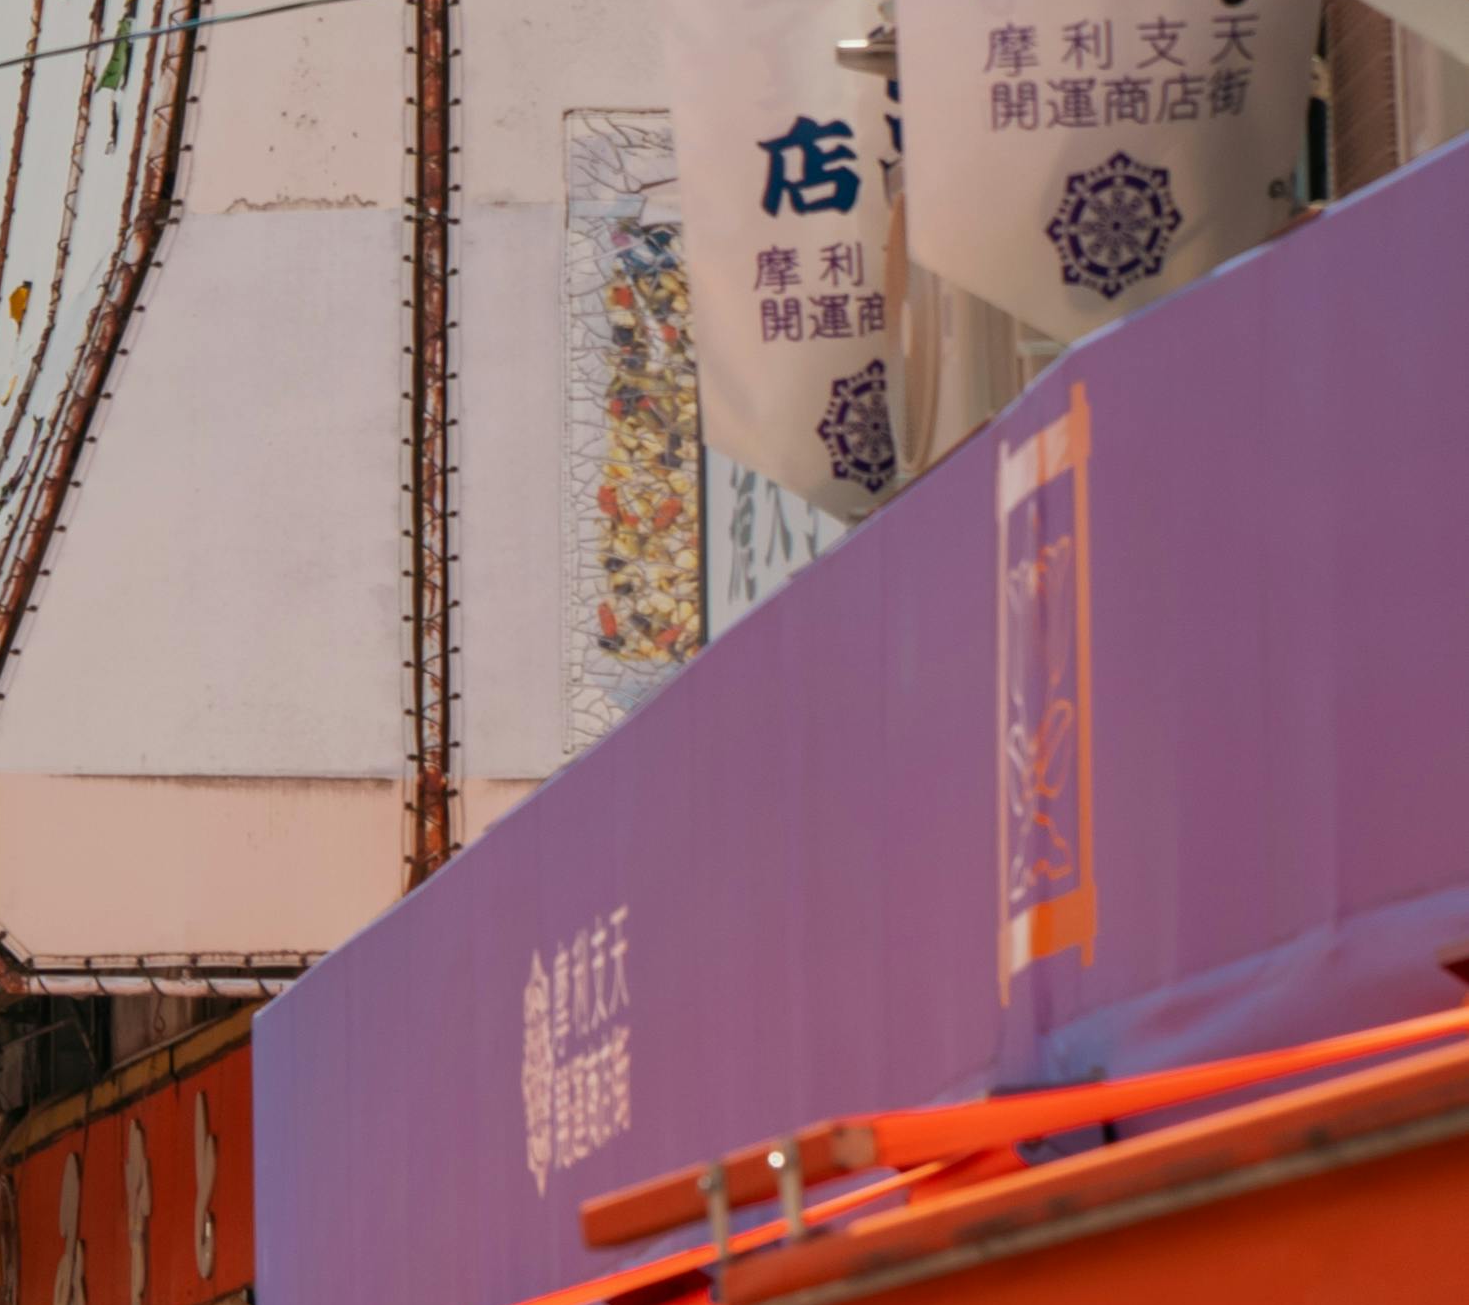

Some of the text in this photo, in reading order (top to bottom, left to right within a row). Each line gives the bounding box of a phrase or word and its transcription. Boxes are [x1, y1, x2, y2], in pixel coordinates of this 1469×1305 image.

[983, 11, 1261, 78] 摩利支天
[993, 65, 1253, 132] 開運商店街
